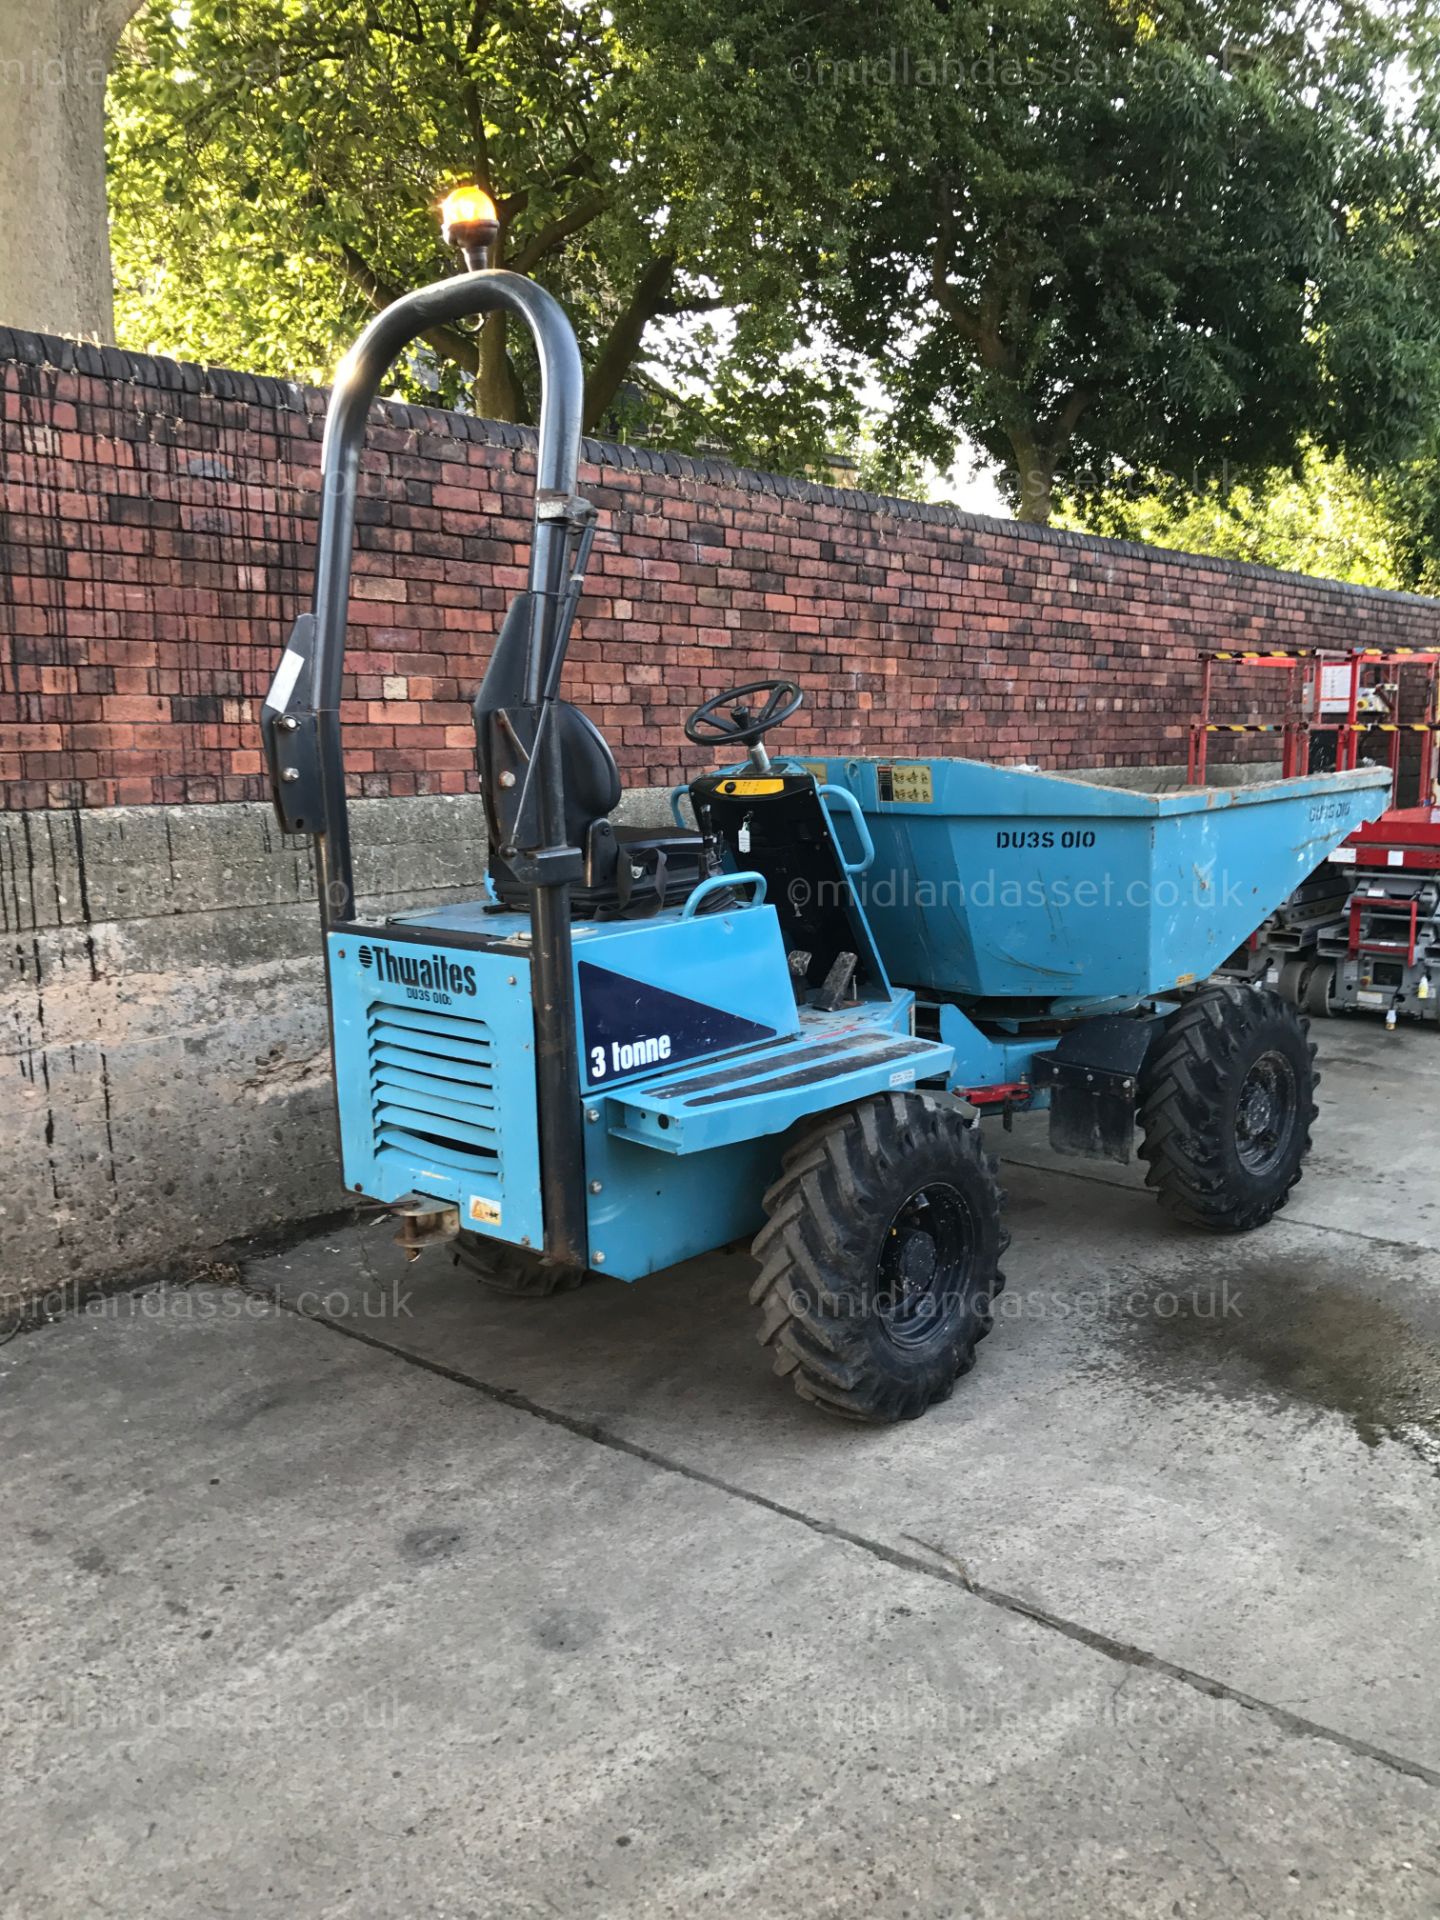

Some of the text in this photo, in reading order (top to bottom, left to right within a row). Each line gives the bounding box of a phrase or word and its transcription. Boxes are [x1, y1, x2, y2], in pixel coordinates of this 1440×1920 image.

[997, 832, 1054, 848] DU3S
[372, 946, 477, 997] Thwaites
[591, 1034, 671, 1078] 3 tonne
